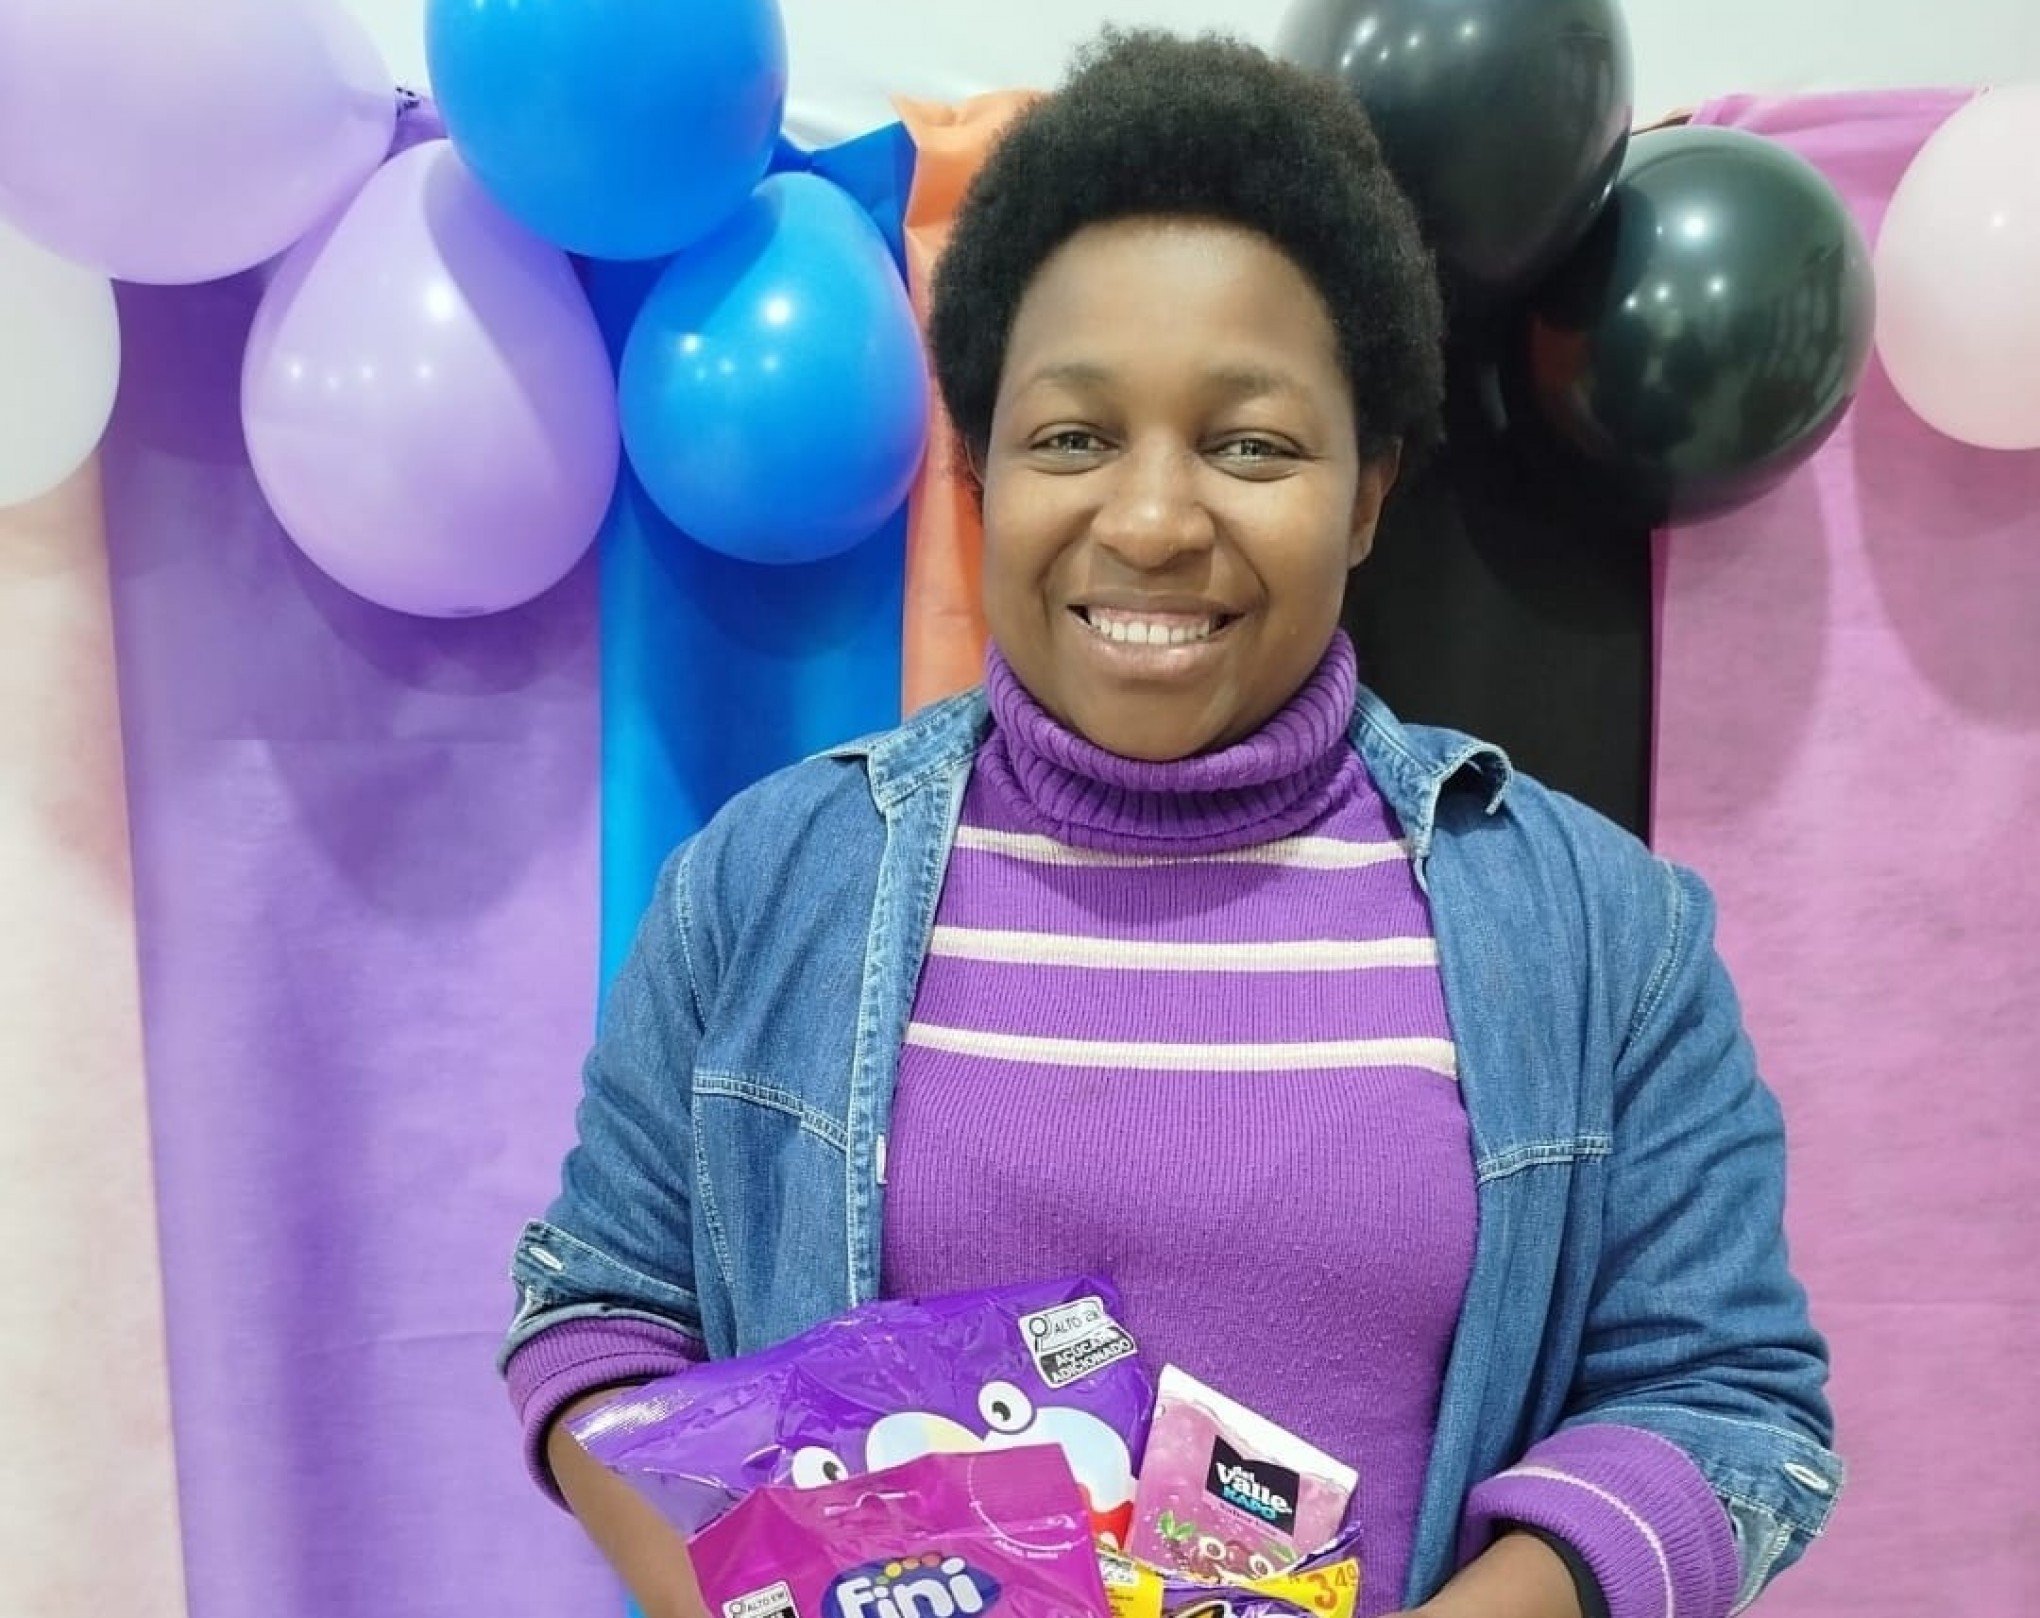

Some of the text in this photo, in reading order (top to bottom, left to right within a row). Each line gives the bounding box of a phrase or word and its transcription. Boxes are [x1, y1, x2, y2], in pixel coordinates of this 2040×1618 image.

[1055, 1316, 1083, 1333] ALTO
[1051, 1338, 1132, 1383] ADICIONADO
[1216, 1462, 1292, 1514] Valle
[747, 1597, 770, 1612] ALTO
